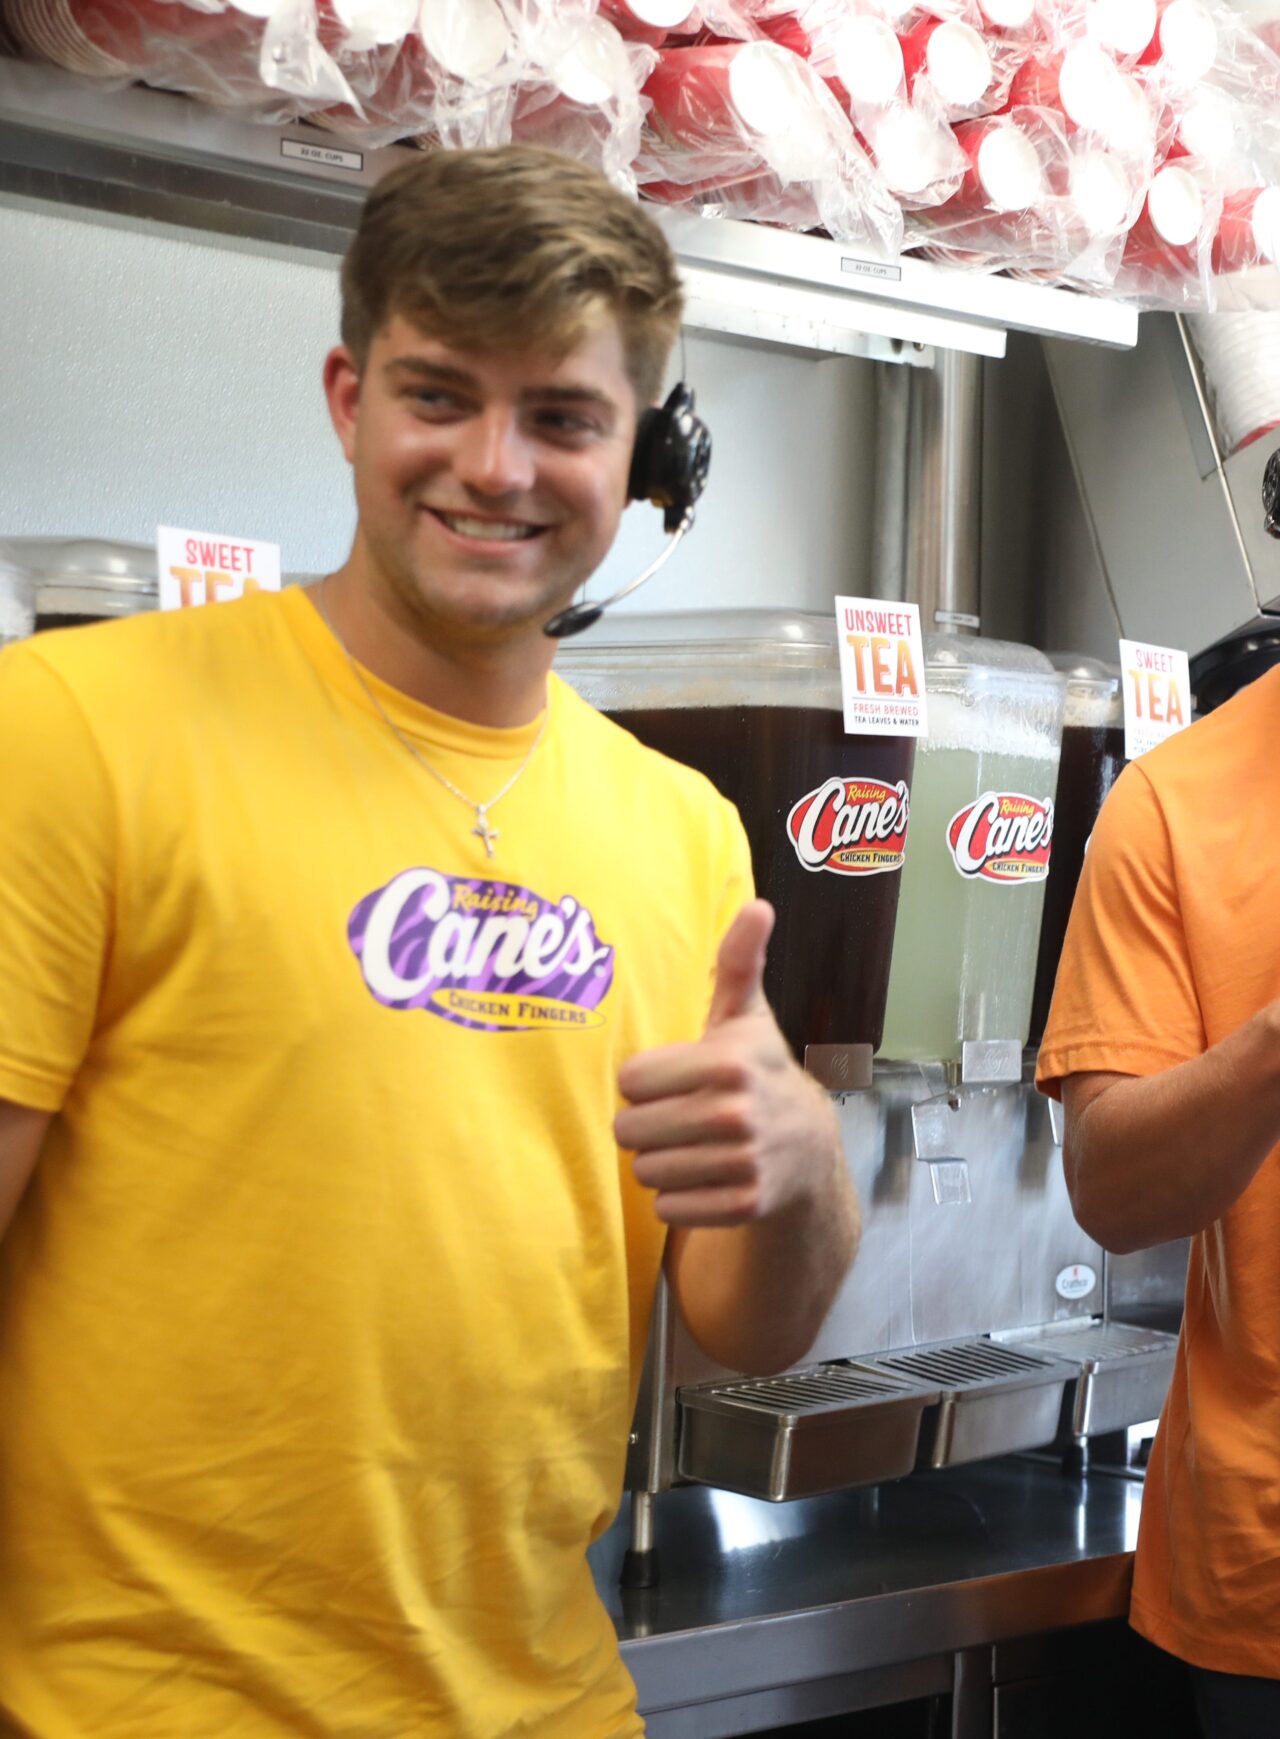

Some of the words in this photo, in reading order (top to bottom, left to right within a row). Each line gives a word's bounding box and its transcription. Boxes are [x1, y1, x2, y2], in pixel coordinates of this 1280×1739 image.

[185, 538, 255, 573] SWEET
[844, 608, 912, 637] UNSWEET
[846, 635, 919, 696] TEA
[1135, 649, 1174, 673] SWEET
[853, 703, 881, 715] FRESH
[884, 705, 919, 717] BREWED
[1128, 669, 1184, 726] TEA
[854, 716, 866, 724] TEA
[868, 716, 891, 726] LEAVES
[899, 718, 920, 727] WATER
[846, 785, 887, 804] Raising
[1000, 800, 1035, 818] Raising
[797, 779, 908, 864] Cane's
[956, 794, 1053, 872] Cane's
[840, 852, 871, 863] CHICKEN
[452, 884, 539, 922] Raising
[361, 866, 610, 1001] Cane's
[449, 991, 511, 1018] CHICKEN
[518, 1002, 588, 1025] FINGERS
